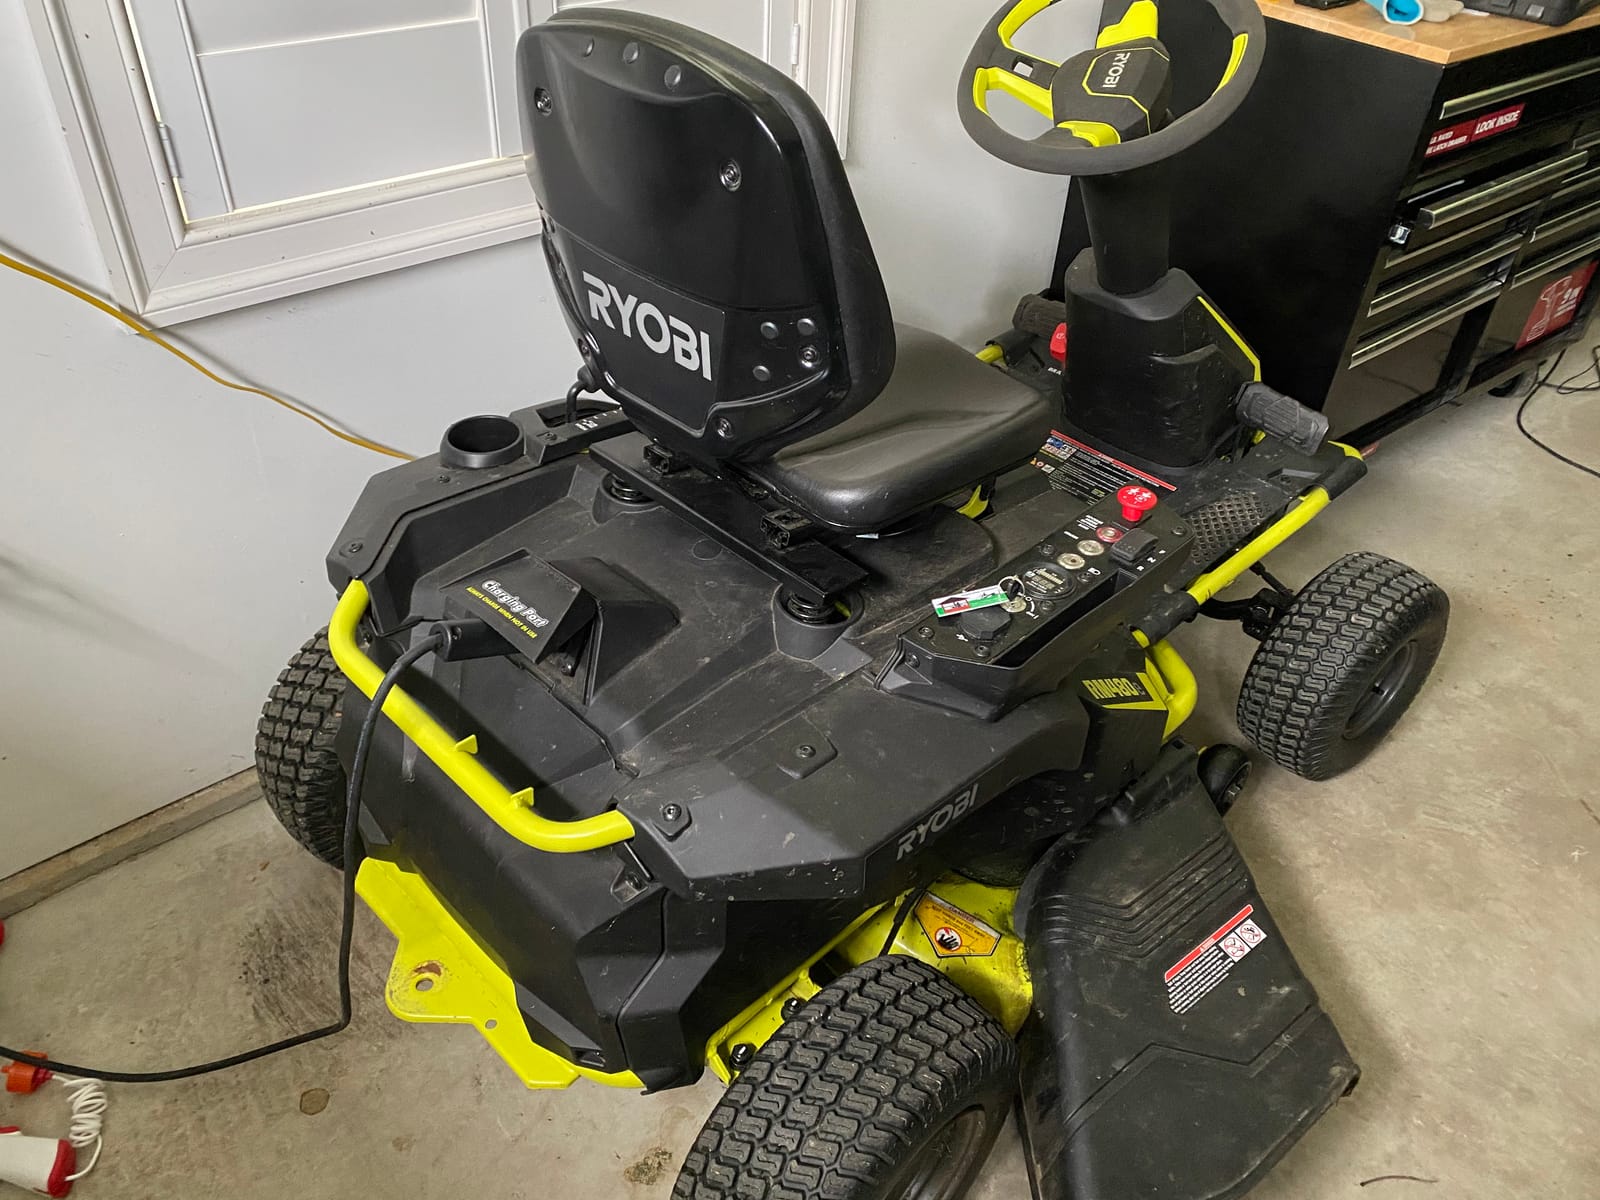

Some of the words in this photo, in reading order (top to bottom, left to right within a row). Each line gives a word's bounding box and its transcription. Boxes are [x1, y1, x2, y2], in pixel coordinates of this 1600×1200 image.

[1101, 52, 1131, 88] RYOBI
[1475, 118, 1497, 135] LOOK
[1495, 110, 1520, 127] INSIDE
[582, 270, 712, 382] RYOBI
[482, 580, 527, 612] Charging
[520, 607, 549, 627] Port
[497, 606, 514, 620] WHEN
[511, 617, 524, 628] NOT
[526, 628, 538, 639] USE
[896, 783, 979, 861] RYOBI
